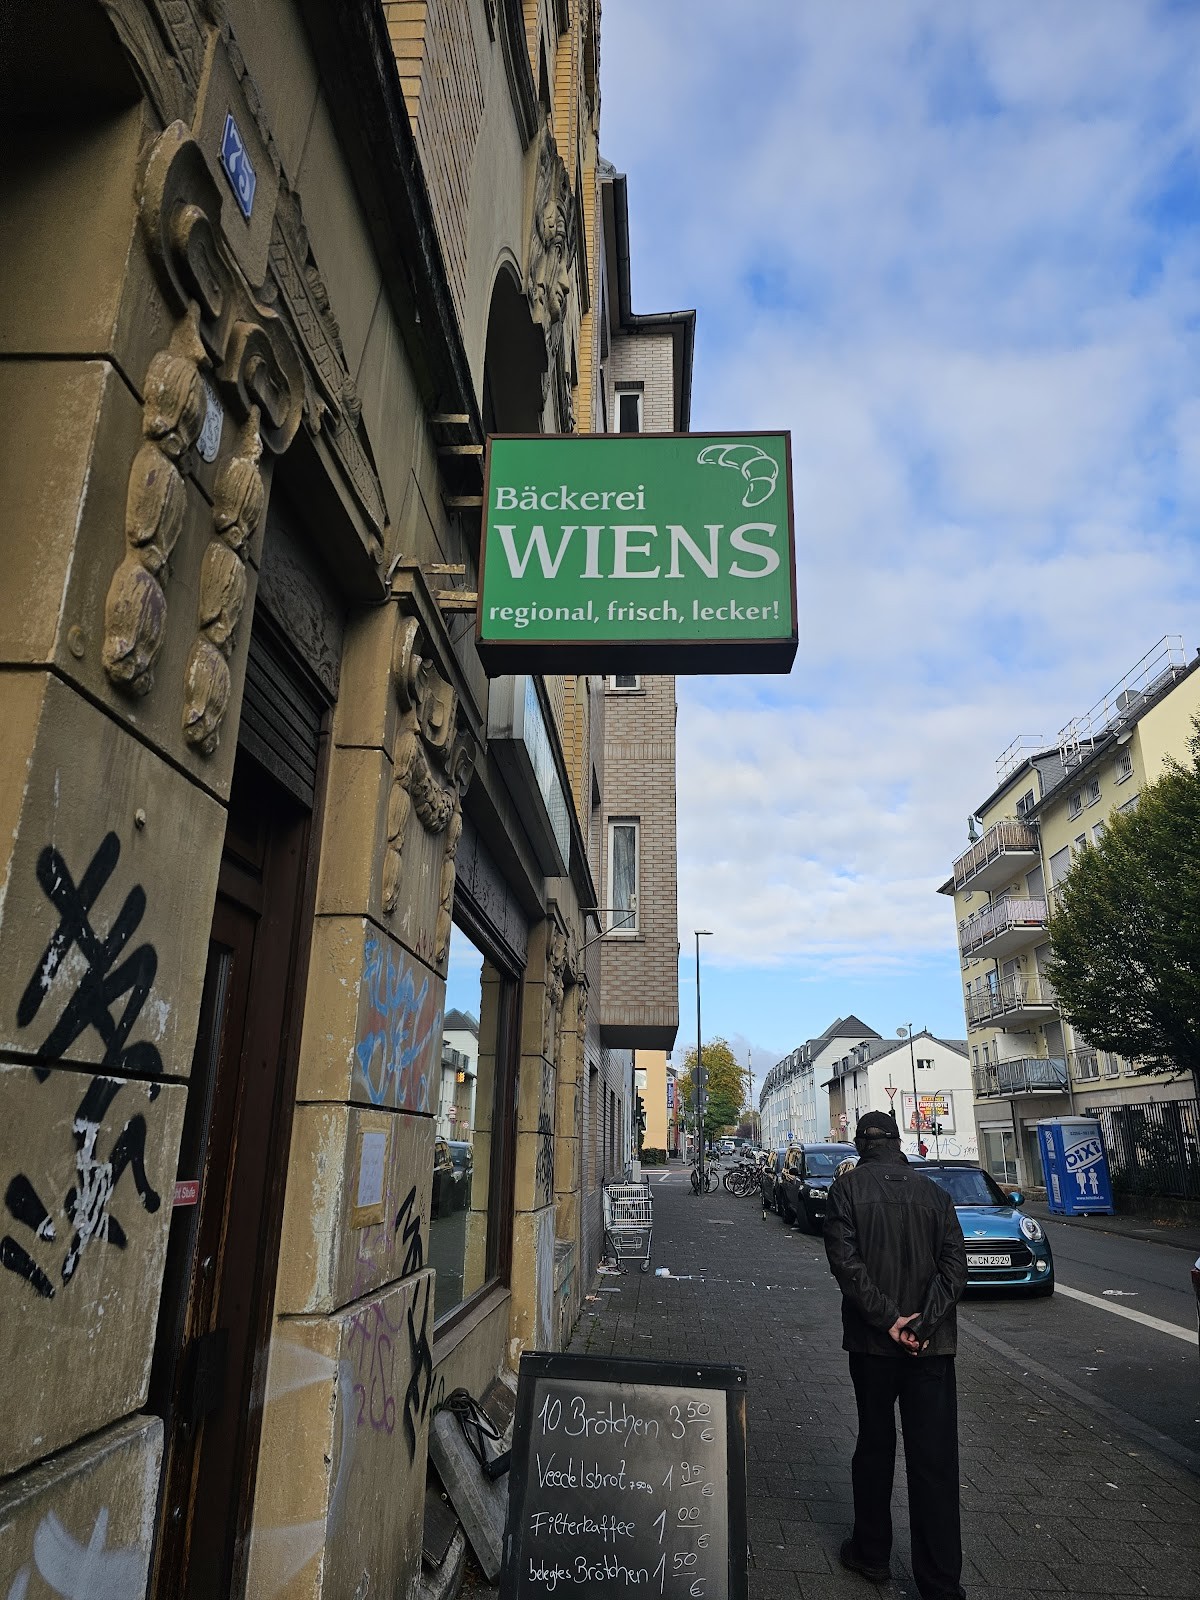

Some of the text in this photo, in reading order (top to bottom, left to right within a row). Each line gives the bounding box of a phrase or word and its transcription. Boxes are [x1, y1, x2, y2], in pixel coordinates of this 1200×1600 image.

[494, 485, 646, 511] Bäckerei
[493, 522, 781, 579] WIENS
[489, 600, 779, 628] regional, frisch, lecker!
[990, 1256, 1010, 1265] 2929
[538, 1394, 562, 1435] 10
[564, 1396, 660, 1448] Brötchen
[669, 1405, 686, 1439] 3
[536, 1453, 626, 1490] Veedelsbrot
[530, 1511, 636, 1543] Filterkaffee
[573, 1554, 649, 1586] Brötchen
